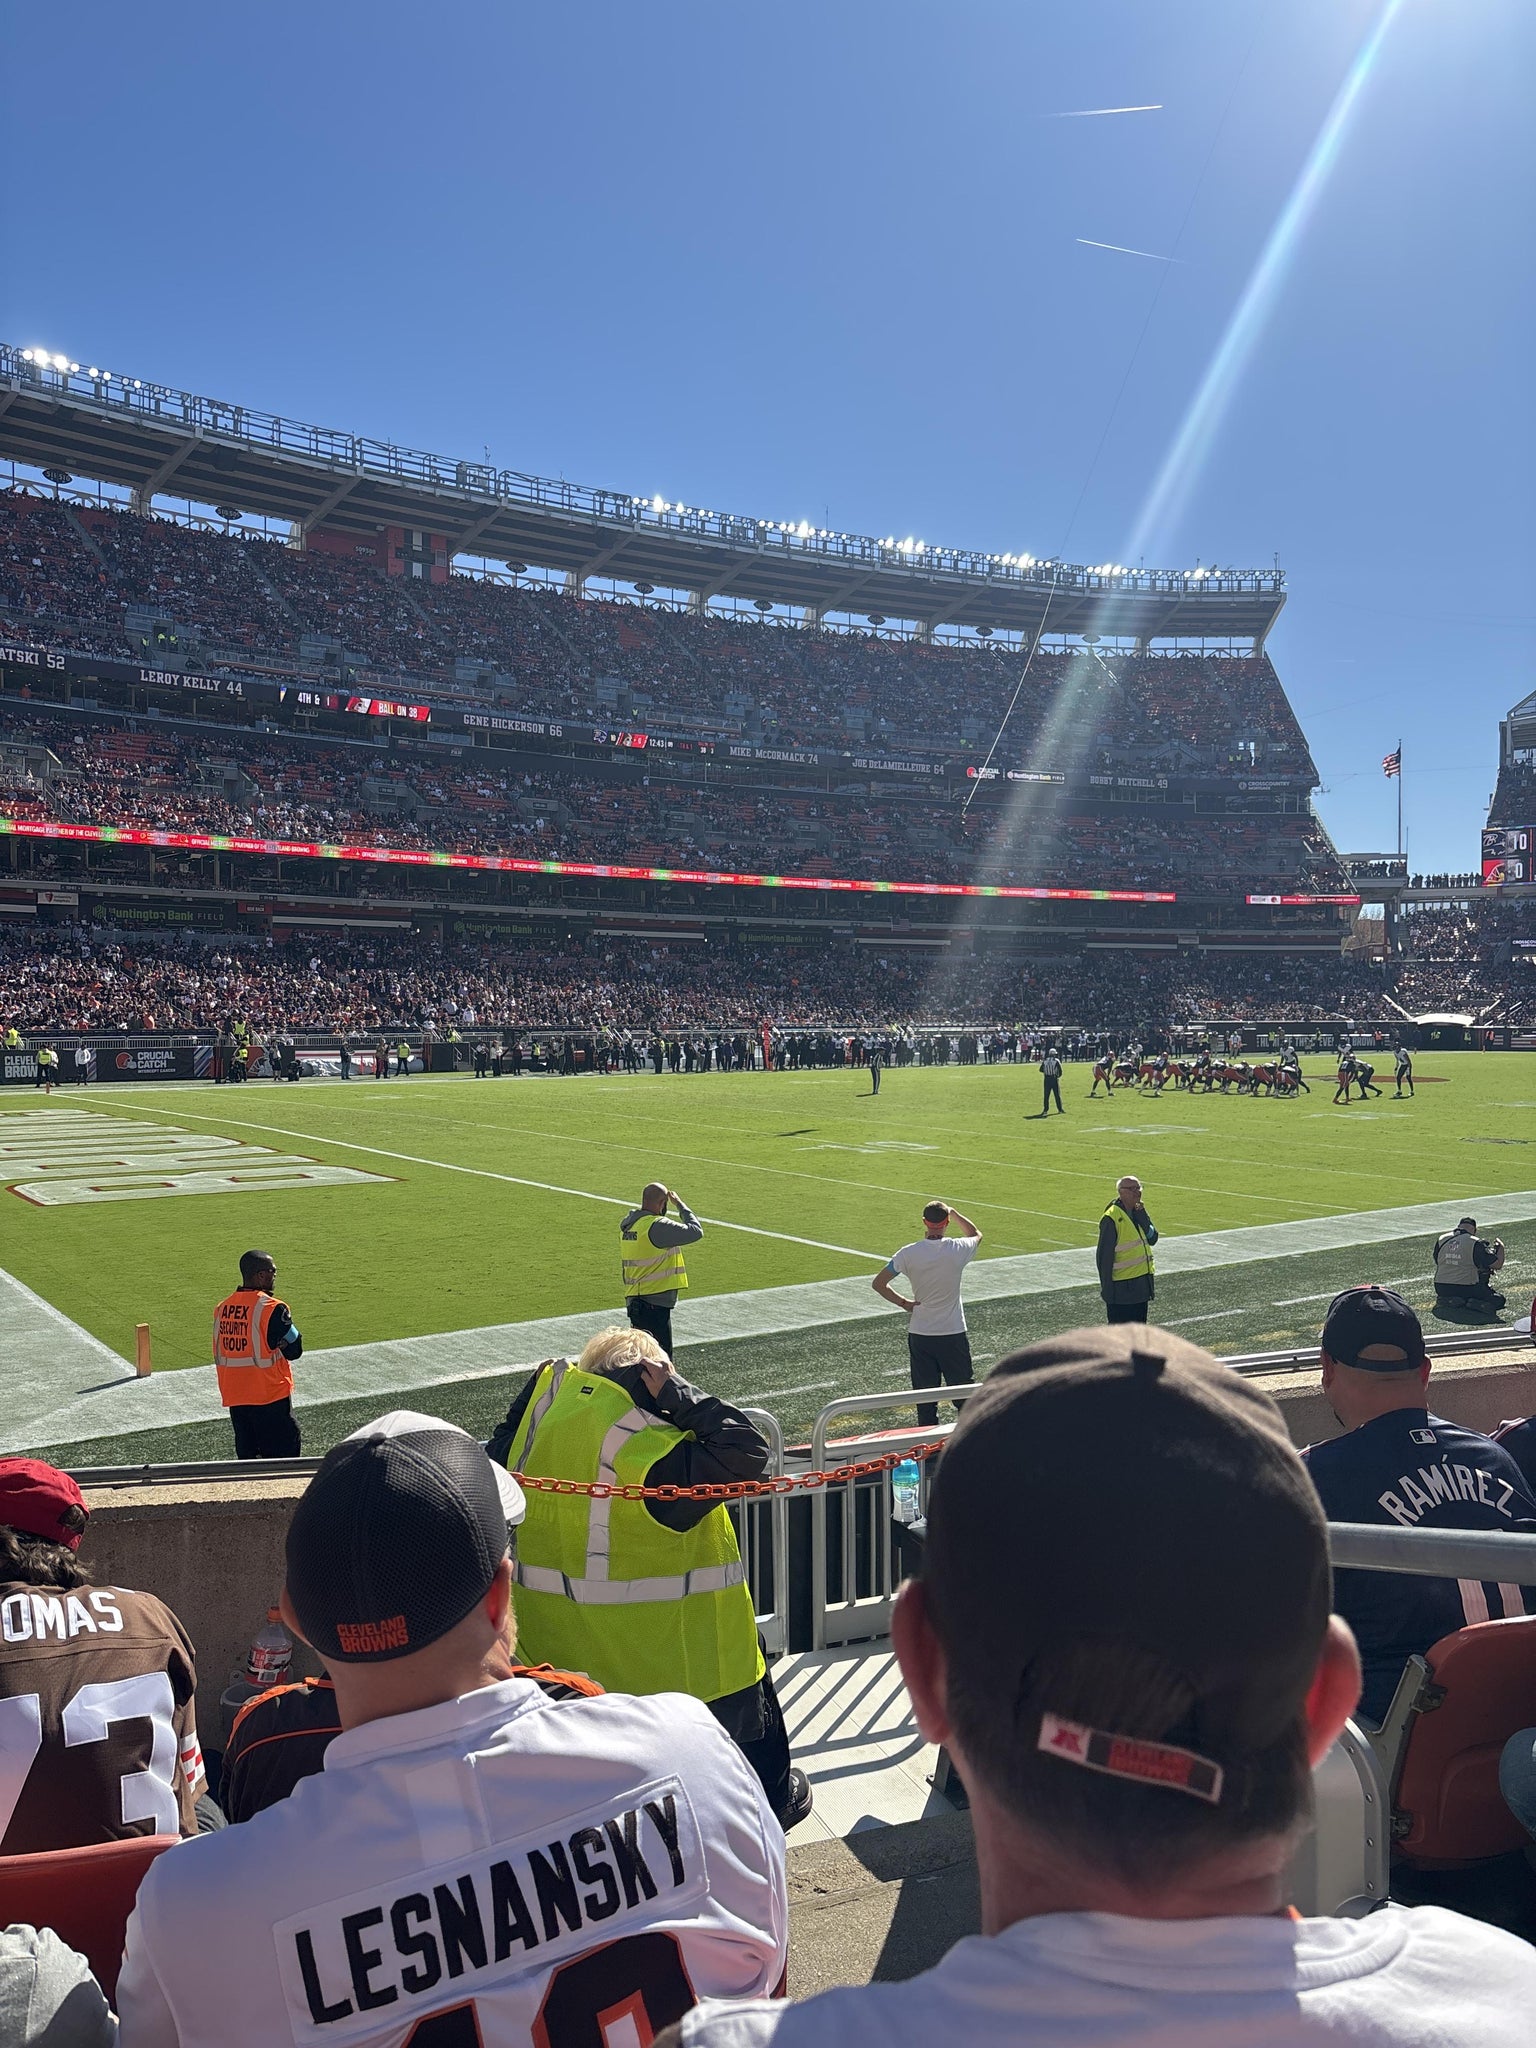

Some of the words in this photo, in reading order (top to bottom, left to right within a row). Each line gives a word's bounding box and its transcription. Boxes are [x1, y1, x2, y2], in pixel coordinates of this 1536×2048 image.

[46, 653, 65, 670] 52
[140, 669, 180, 686] LEROY
[183, 675, 220, 692] KELLY
[226, 681, 243, 696] 44
[297, 692, 312, 704] 4TH
[314, 697, 321, 705] &
[378, 702, 394, 715] BALL
[396, 705, 407, 717] ON
[408, 707, 418, 719] 38
[463, 714, 489, 727] GENE
[491, 717, 545, 734] HICKERSON
[549, 724, 563, 737] 66
[729, 746, 751, 757] MIKE
[808, 753, 819, 765] 74
[852, 758, 867, 768] JOE
[933, 764, 945, 775] 64
[1090, 775, 1113, 785] BOBBY
[1117, 777, 1155, 788] MITCHELL
[1157, 779, 1168, 789] 49
[1513, 833, 1527, 849] 10
[1515, 862, 1523, 878] 0
[167, 908, 194, 921] Bank
[197, 912, 224, 921] FIELD
[4, 1055, 36, 1066] CLEVEL
[137, 1051, 176, 1060] CRUCIAL
[137, 1060, 167, 1069] CATCH
[221, 1304, 250, 1321] APEX
[219, 1320, 249, 1335] SECURITY
[1377, 1453, 1514, 1527] RAMÍREZ
[2, 1591, 125, 1643] OMAS
[336, 1614, 406, 1638] CLEVELAND
[340, 1629, 409, 1653] BROWNS
[294, 1794, 686, 2025] LESNANSKY
